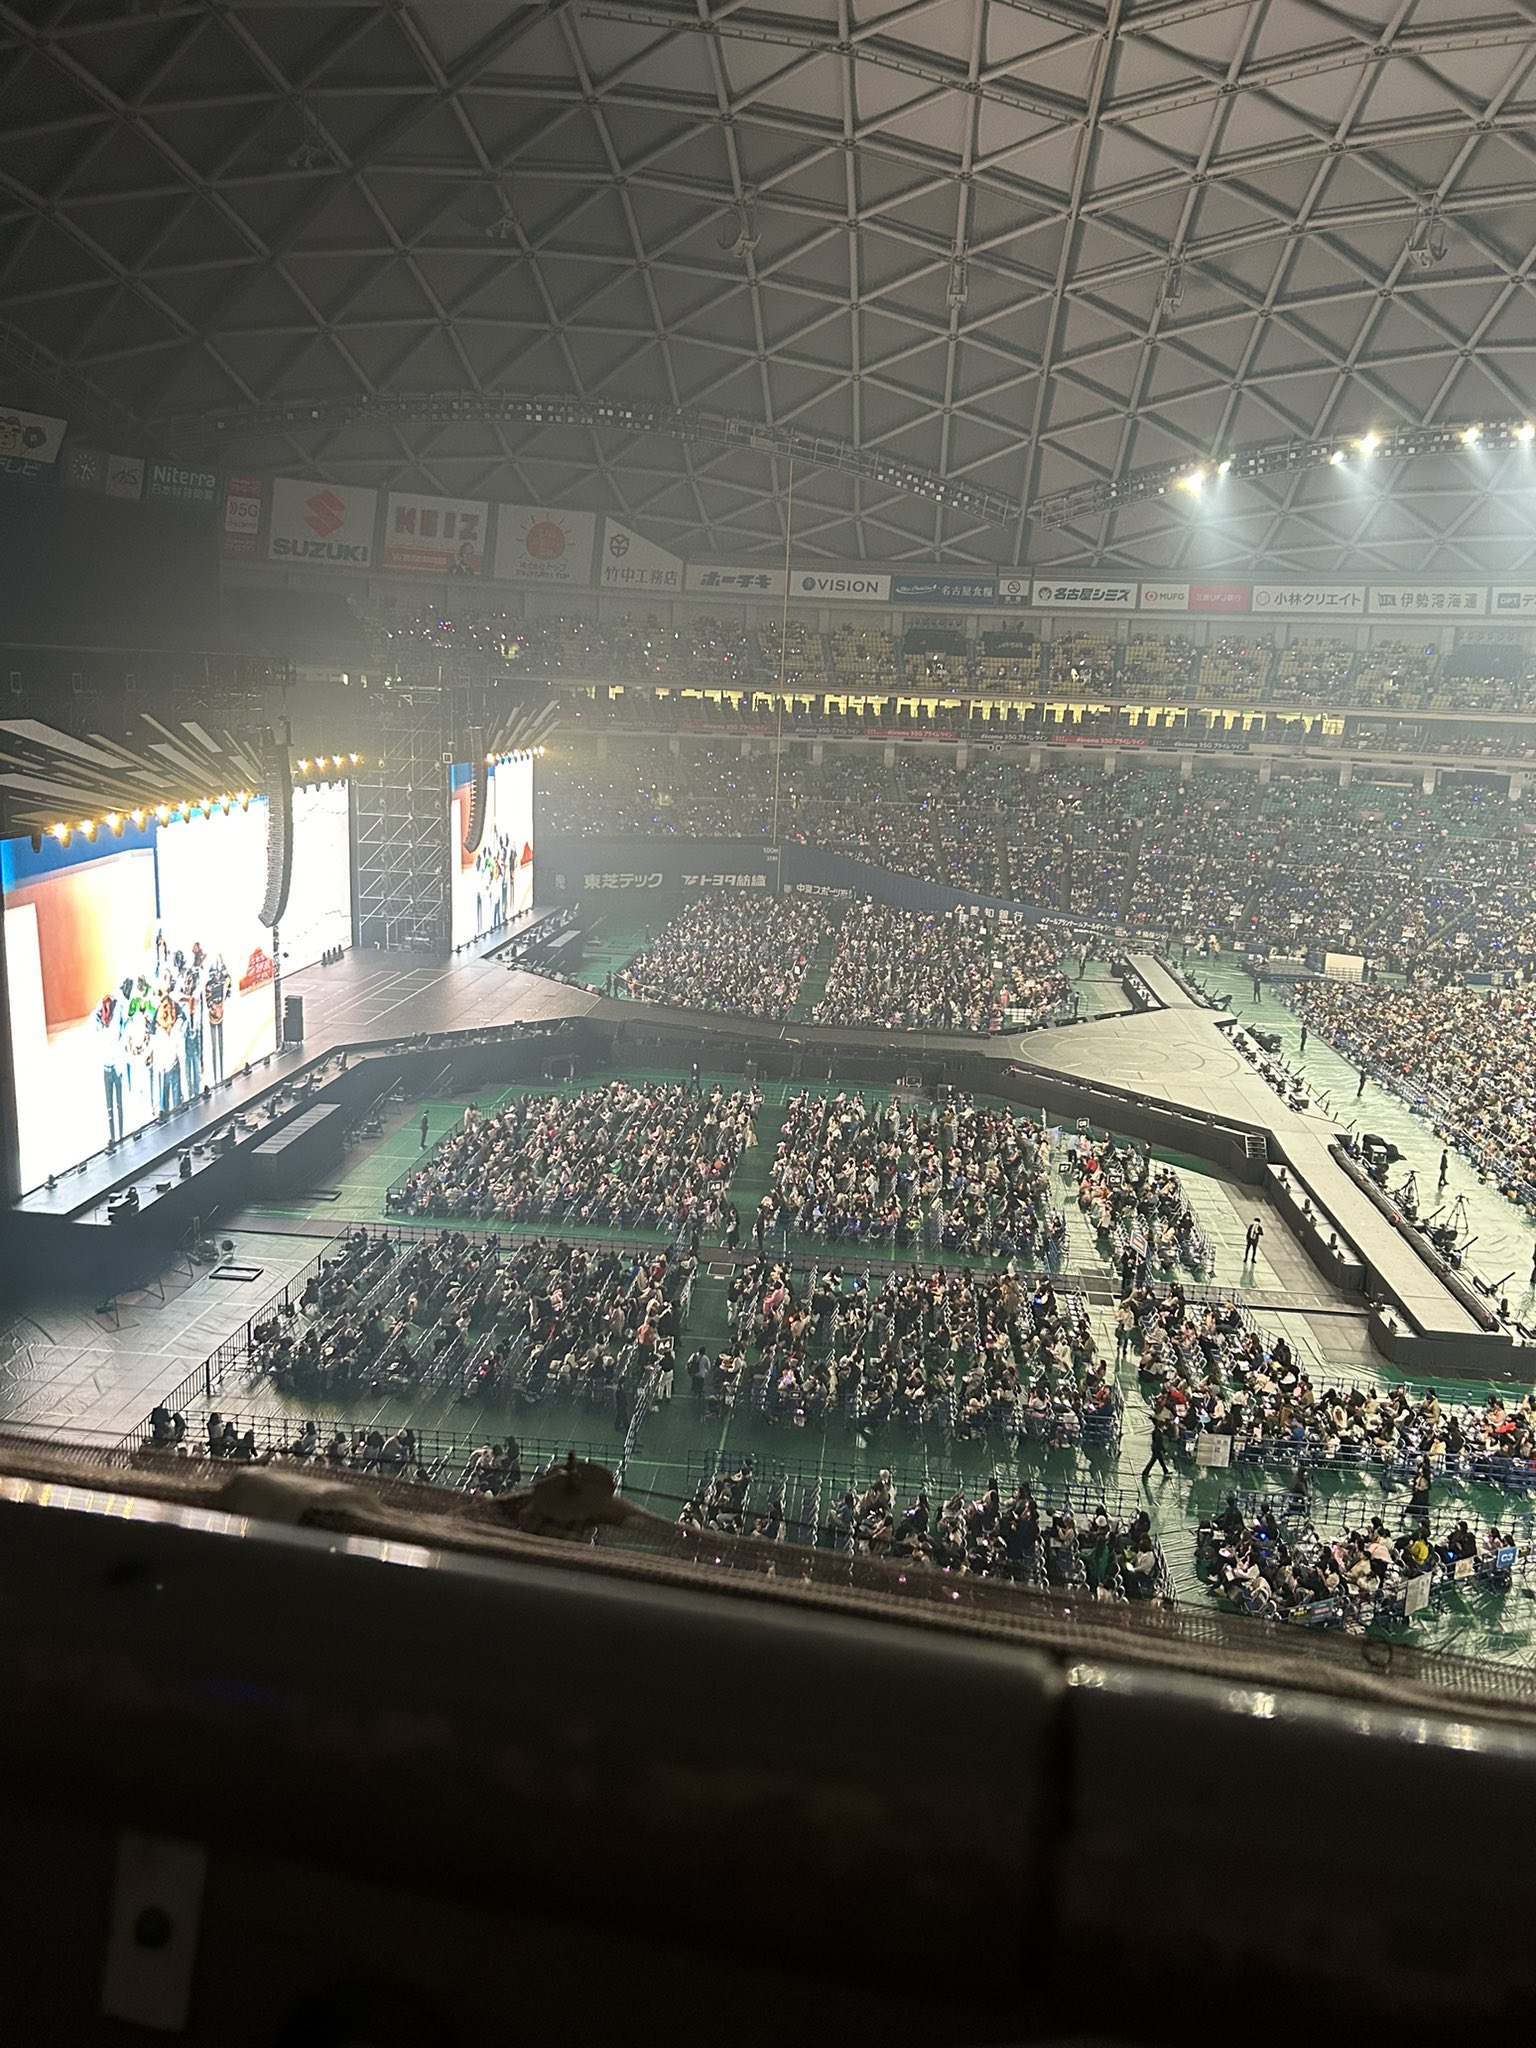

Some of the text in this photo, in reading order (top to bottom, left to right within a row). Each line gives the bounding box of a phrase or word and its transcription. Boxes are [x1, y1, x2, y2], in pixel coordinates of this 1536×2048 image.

[153, 465, 216, 487] Niterra
[238, 503, 258, 517] 5G
[273, 537, 369, 562] SUZUKI
[604, 566, 679, 586] 竹中工務店
[700, 571, 772, 589] ホーチキ
[817, 578, 879, 593] VISION
[1054, 587, 1131, 602] 名古屋シミズ
[1159, 592, 1185, 601] MUFG
[1274, 592, 1361, 606] 小林クリエイト
[583, 872, 664, 889] 東芝テック
[700, 874, 767, 887] トヨタ紡織
[1500, 1552, 1514, 1563] C3
